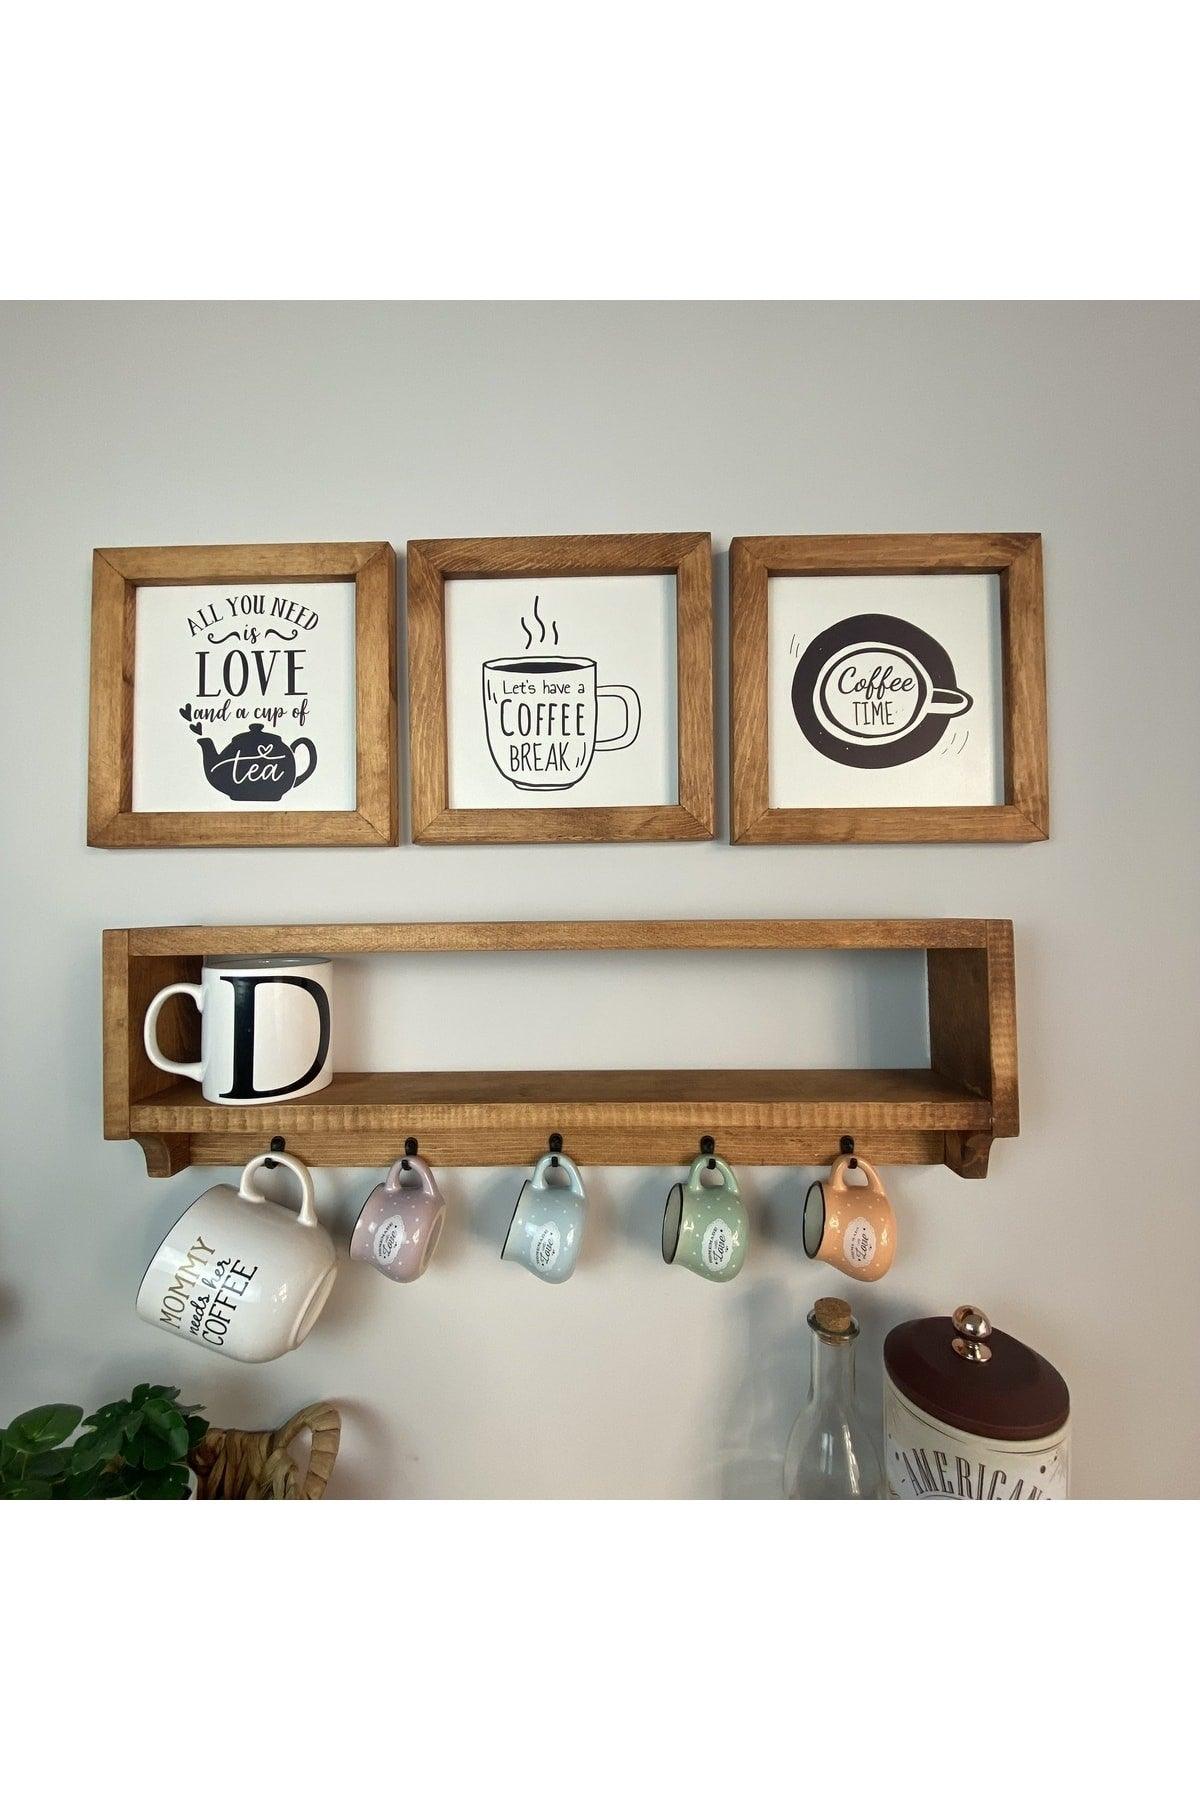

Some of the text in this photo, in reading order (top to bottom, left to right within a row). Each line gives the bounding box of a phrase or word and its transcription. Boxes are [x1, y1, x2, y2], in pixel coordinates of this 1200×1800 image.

[186, 594, 320, 637] ALL YOU NEED
[242, 623, 261, 645] is
[195, 649, 309, 698] LOVE
[502, 679, 586, 695] Let's have a
[837, 665, 917, 701] Coffee
[193, 698, 310, 728] and a cup of
[500, 698, 586, 737] COFFEE
[852, 701, 895, 726] TIME
[210, 749, 286, 785] tea
[509, 741, 571, 773] BREAK
[219, 975, 331, 1100] D
[382, 1230, 398, 1258] Love
[539, 1238, 554, 1265] Love
[713, 1235, 726, 1263] Love
[855, 1233, 869, 1260] Love
[159, 1236, 216, 1330] MOMMY
[189, 1258, 232, 1336] needs her
[201, 1259, 259, 1346] COFFEE
